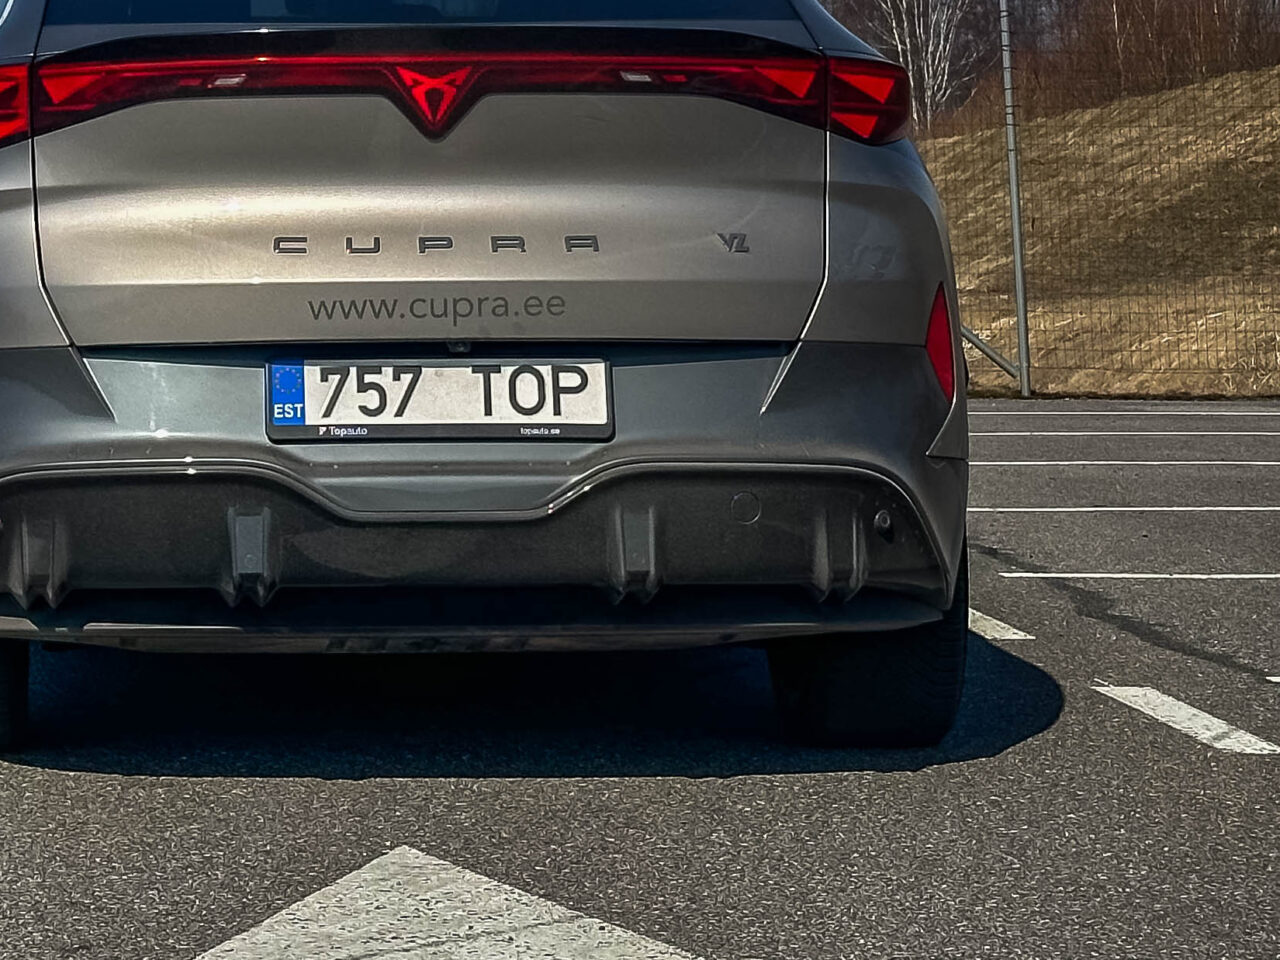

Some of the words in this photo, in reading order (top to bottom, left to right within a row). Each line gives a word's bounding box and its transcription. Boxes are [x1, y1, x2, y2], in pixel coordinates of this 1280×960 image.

[273, 235, 600, 254] CUPRA
[716, 232, 750, 253] VZ
[308, 294, 566, 326] www.cupra.ee
[320, 365, 422, 418] 757
[471, 365, 589, 417] TOP
[274, 403, 304, 418] EST
